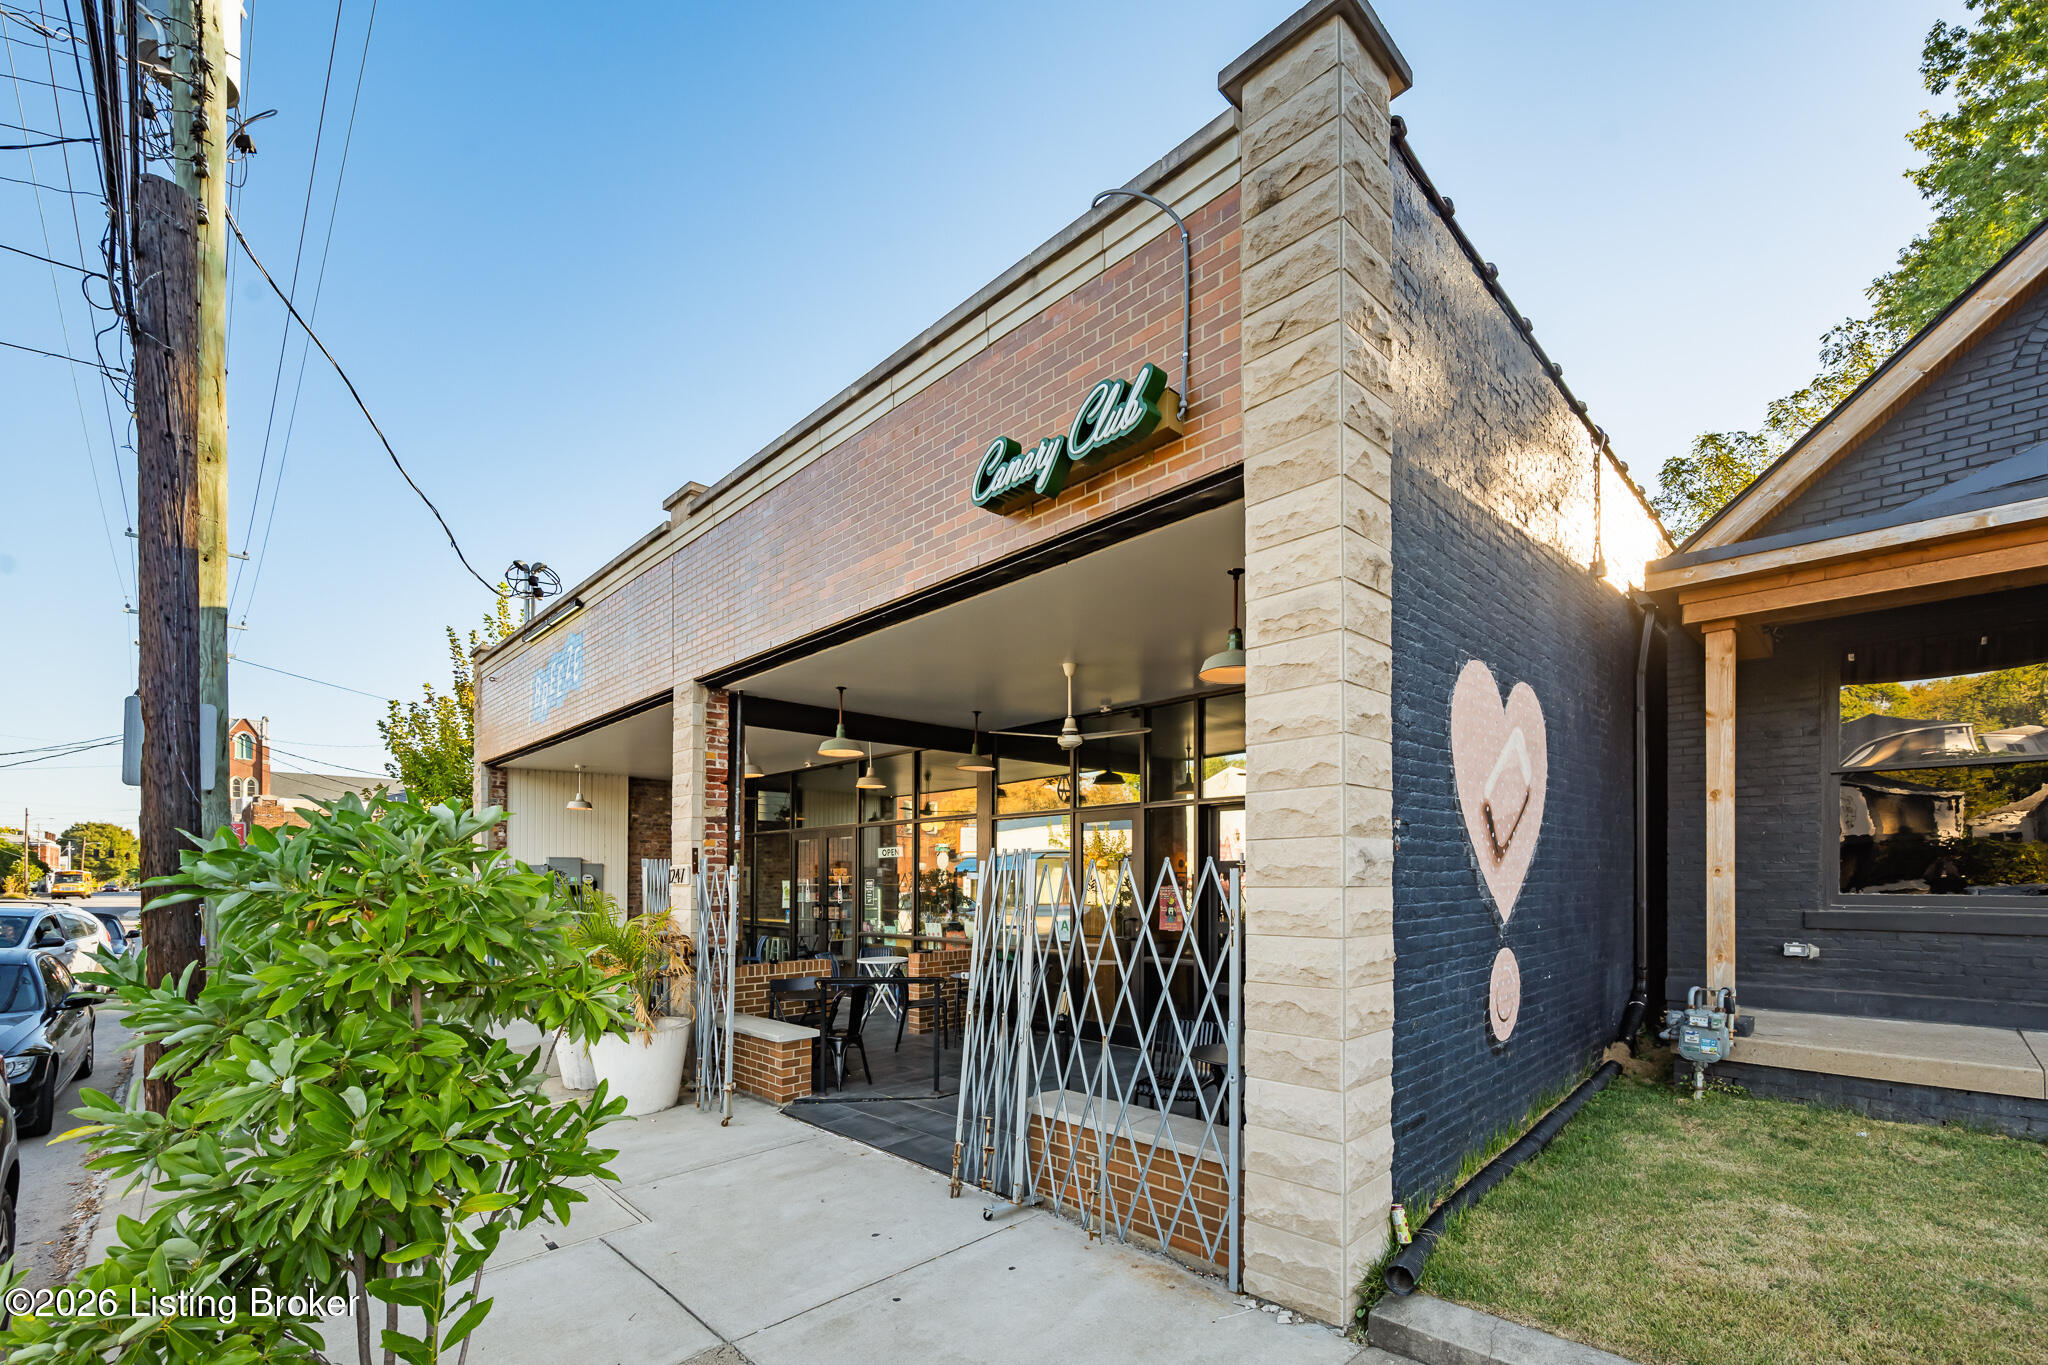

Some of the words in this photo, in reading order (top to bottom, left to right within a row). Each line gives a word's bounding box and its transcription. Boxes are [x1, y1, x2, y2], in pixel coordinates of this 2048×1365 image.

[972, 438, 1062, 503] Canary
[1068, 366, 1146, 458] Club
[881, 848, 900, 857] OPEN
[1061, 919, 1070, 931] A
